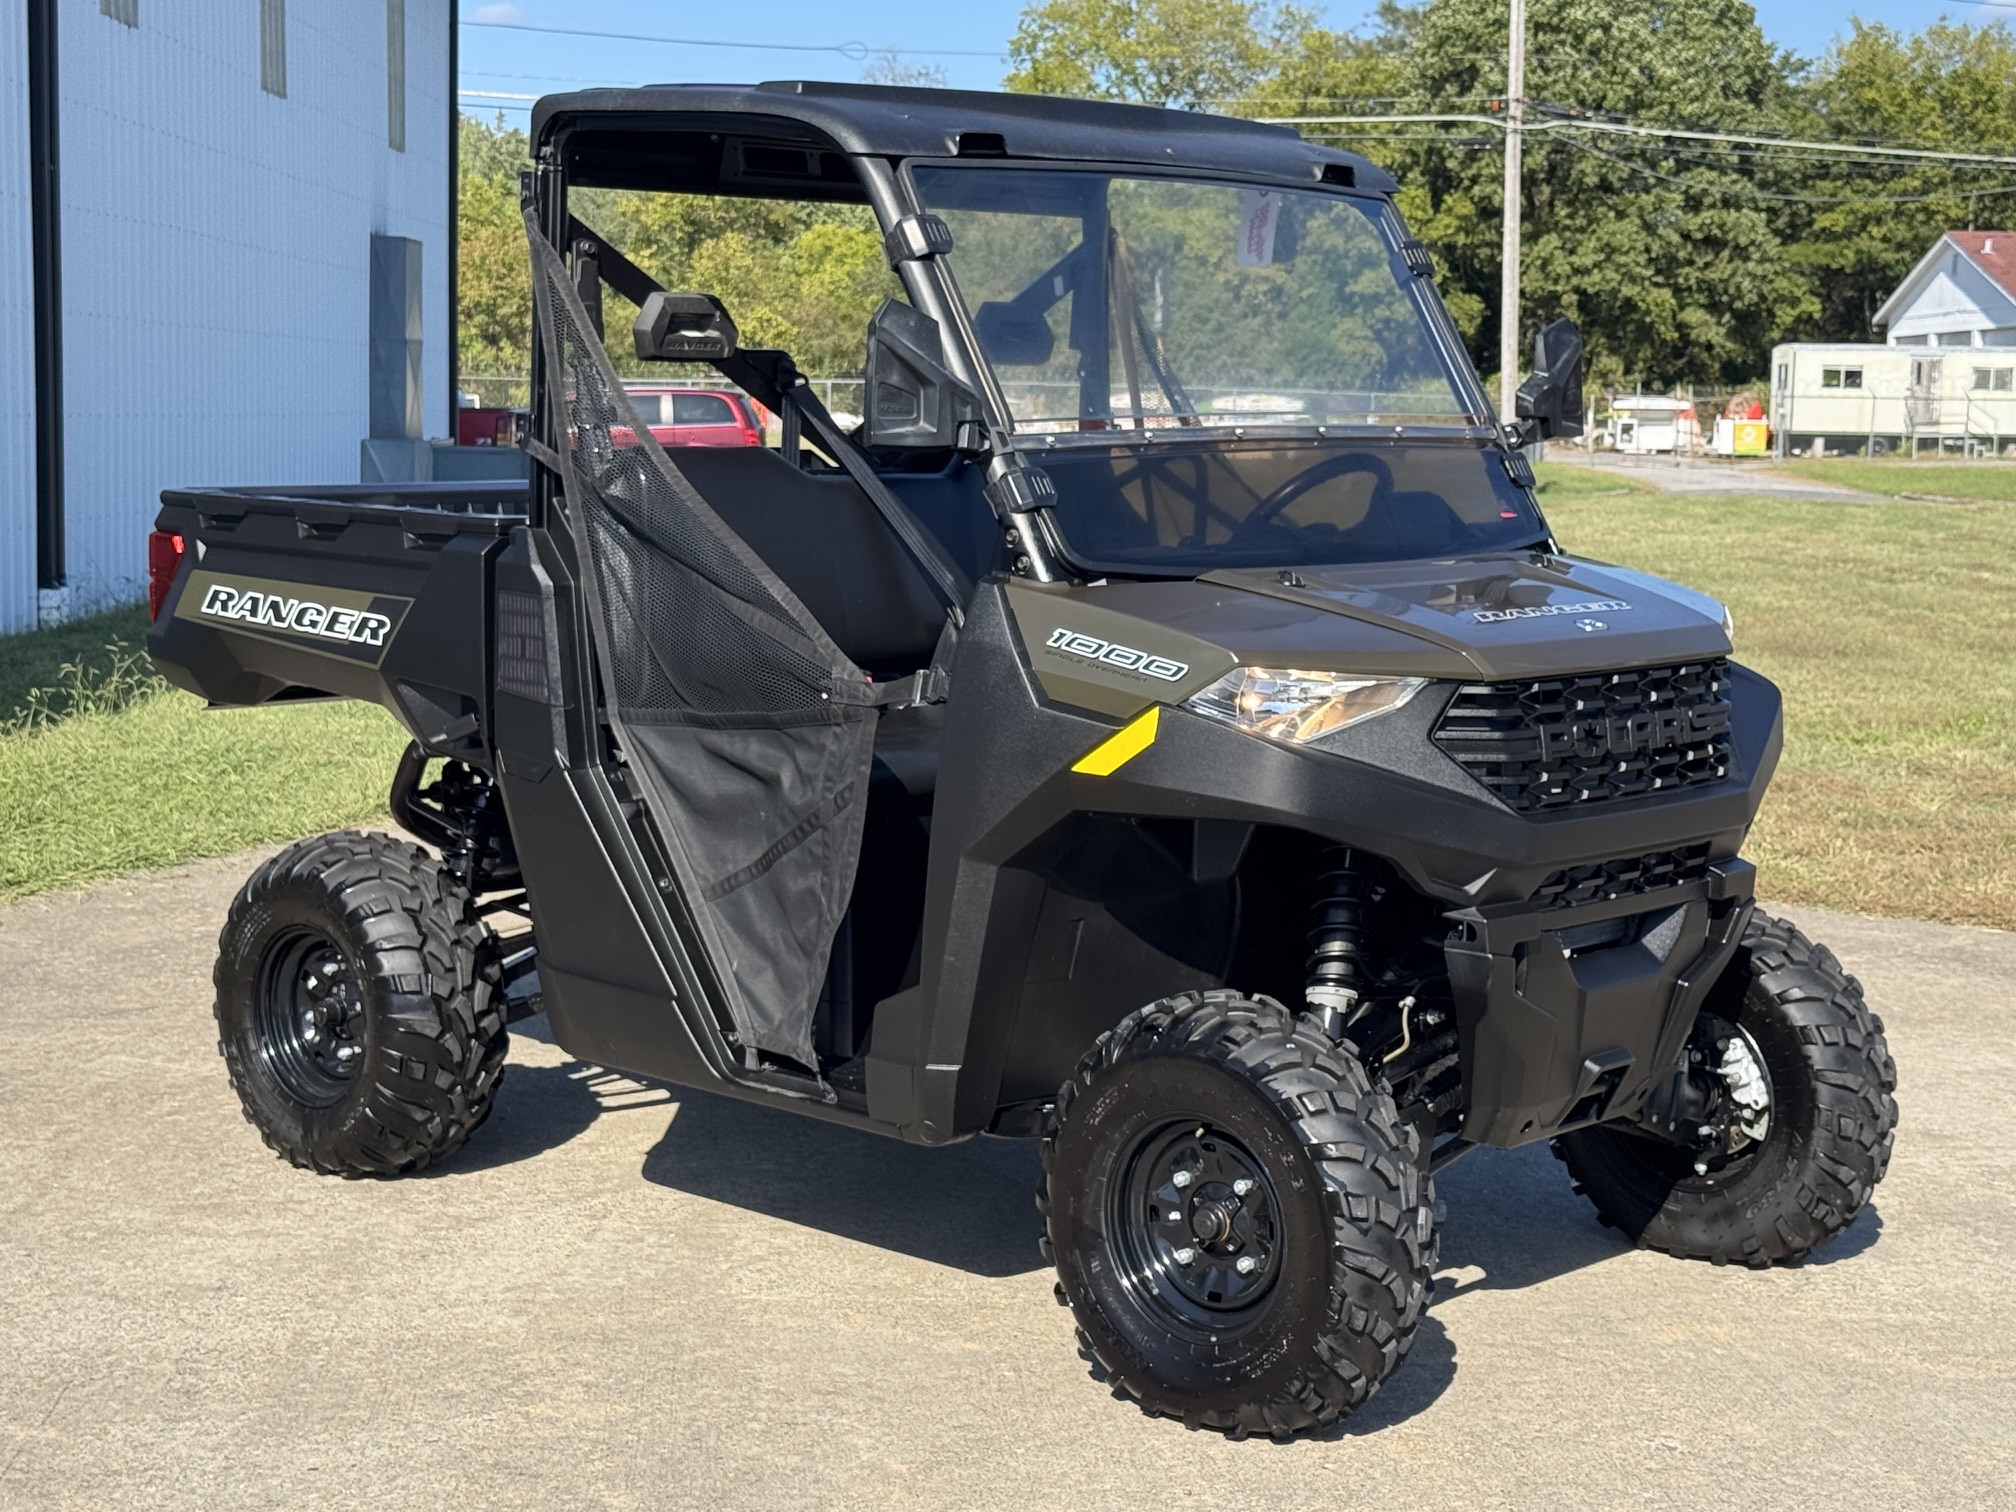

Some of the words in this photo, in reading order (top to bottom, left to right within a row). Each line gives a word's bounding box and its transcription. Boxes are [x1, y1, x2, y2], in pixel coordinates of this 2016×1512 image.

[202, 585, 391, 646] RANGER
[1473, 600, 1632, 622] RANGER
[1046, 628, 1190, 682] 1000
[1540, 702, 1731, 762] POLARIS
